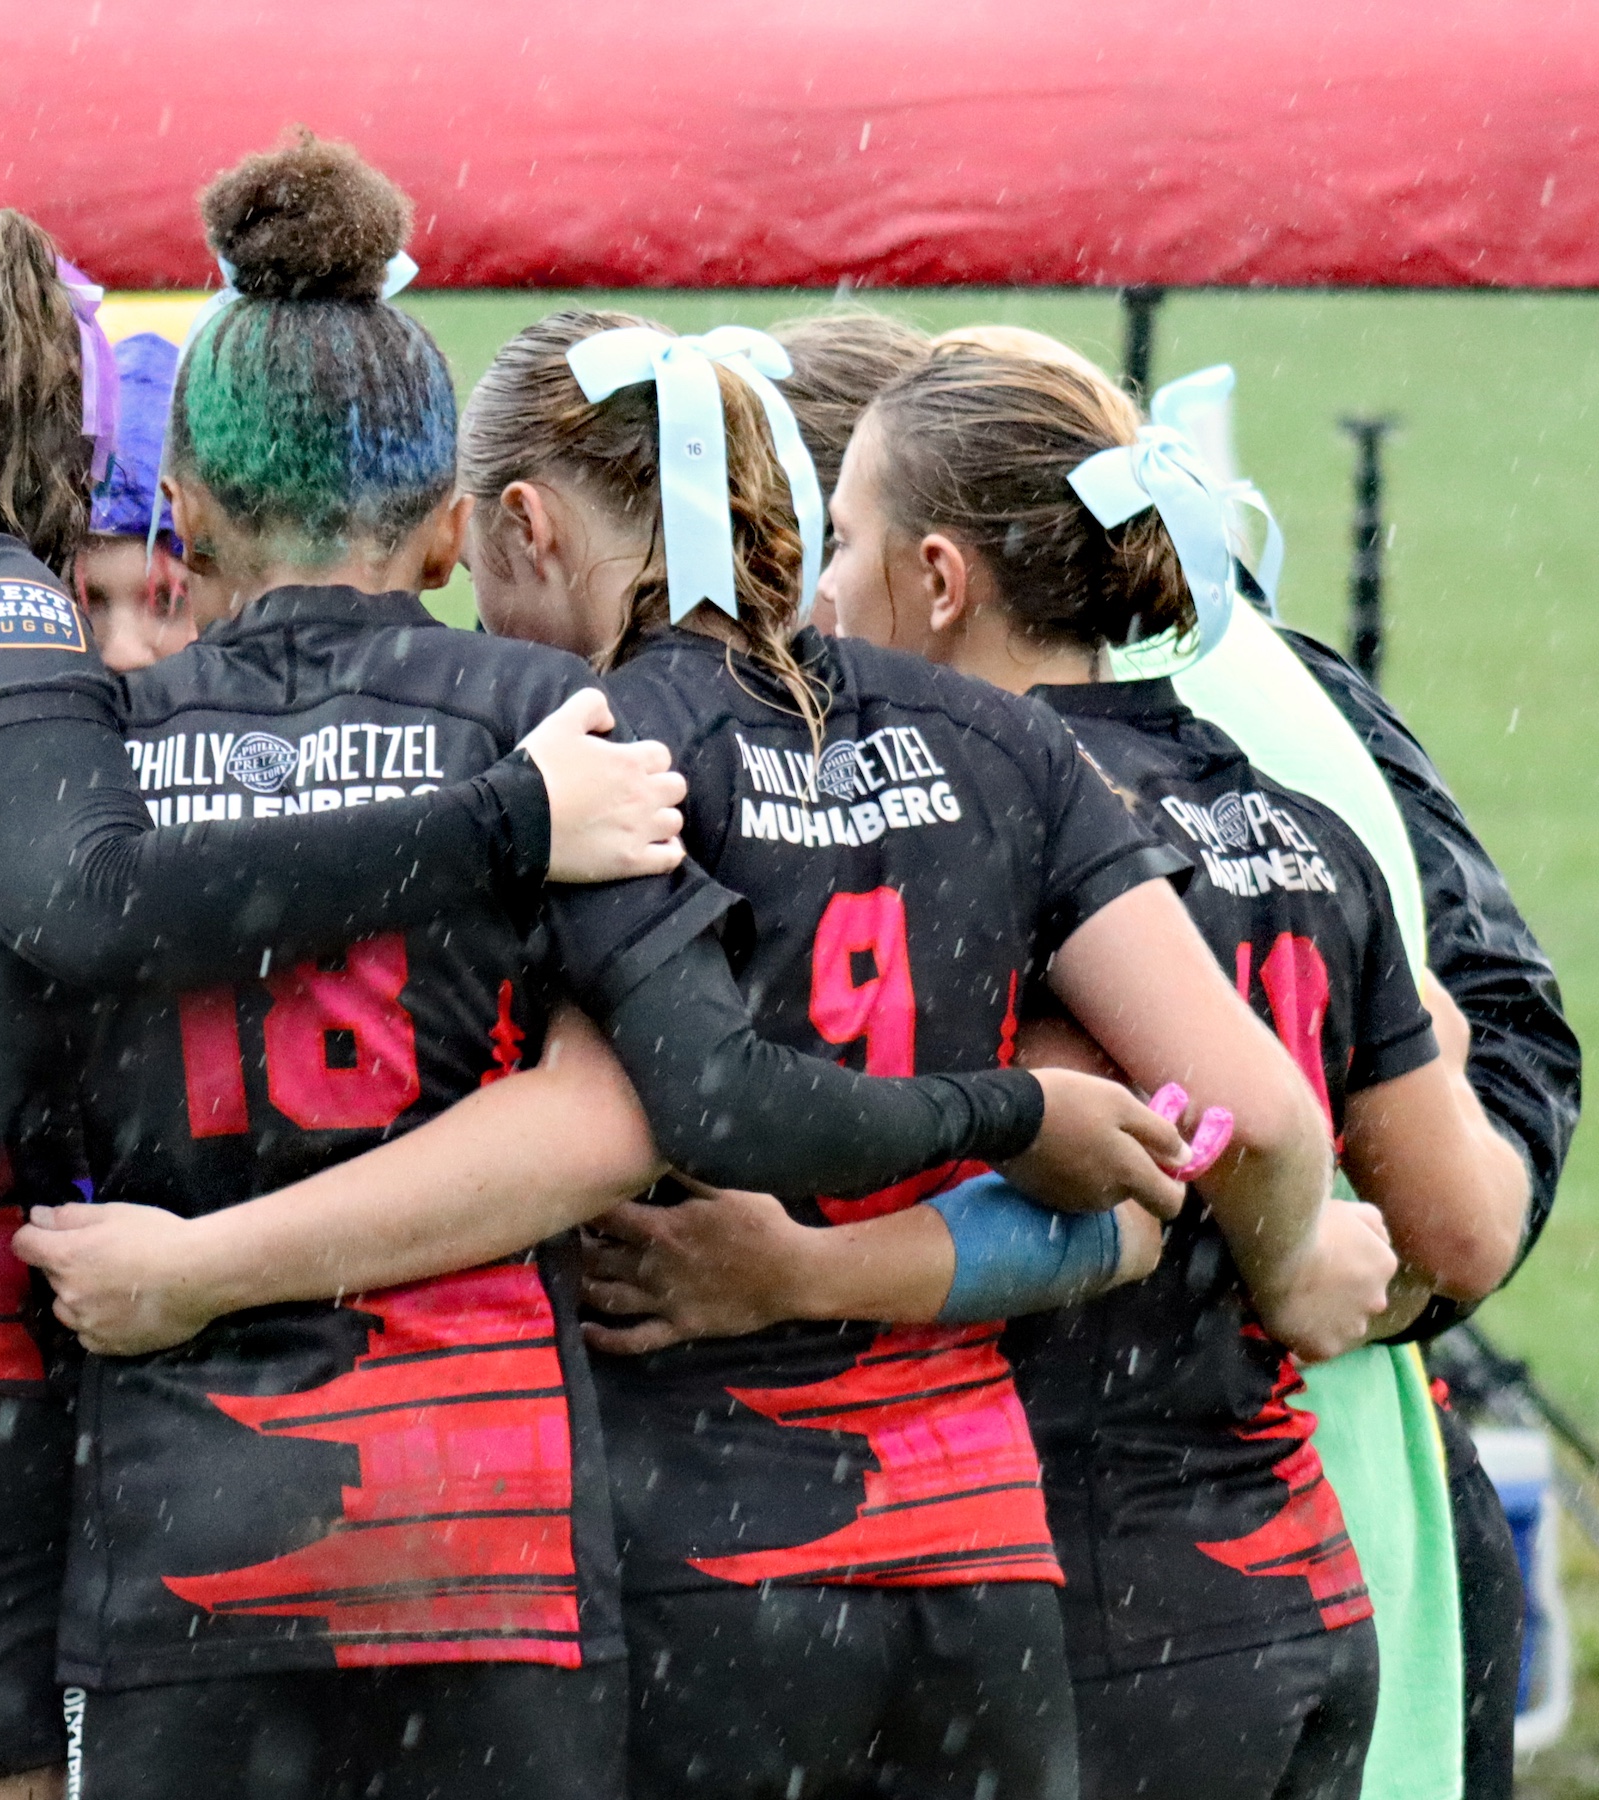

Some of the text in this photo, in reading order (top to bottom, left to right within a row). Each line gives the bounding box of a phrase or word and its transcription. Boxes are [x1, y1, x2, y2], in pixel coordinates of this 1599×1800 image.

[686, 442, 703, 457] 16
[295, 723, 444, 787] PRETZEL
[178, 932, 421, 1139] 18
[808, 885, 916, 1078] 9
